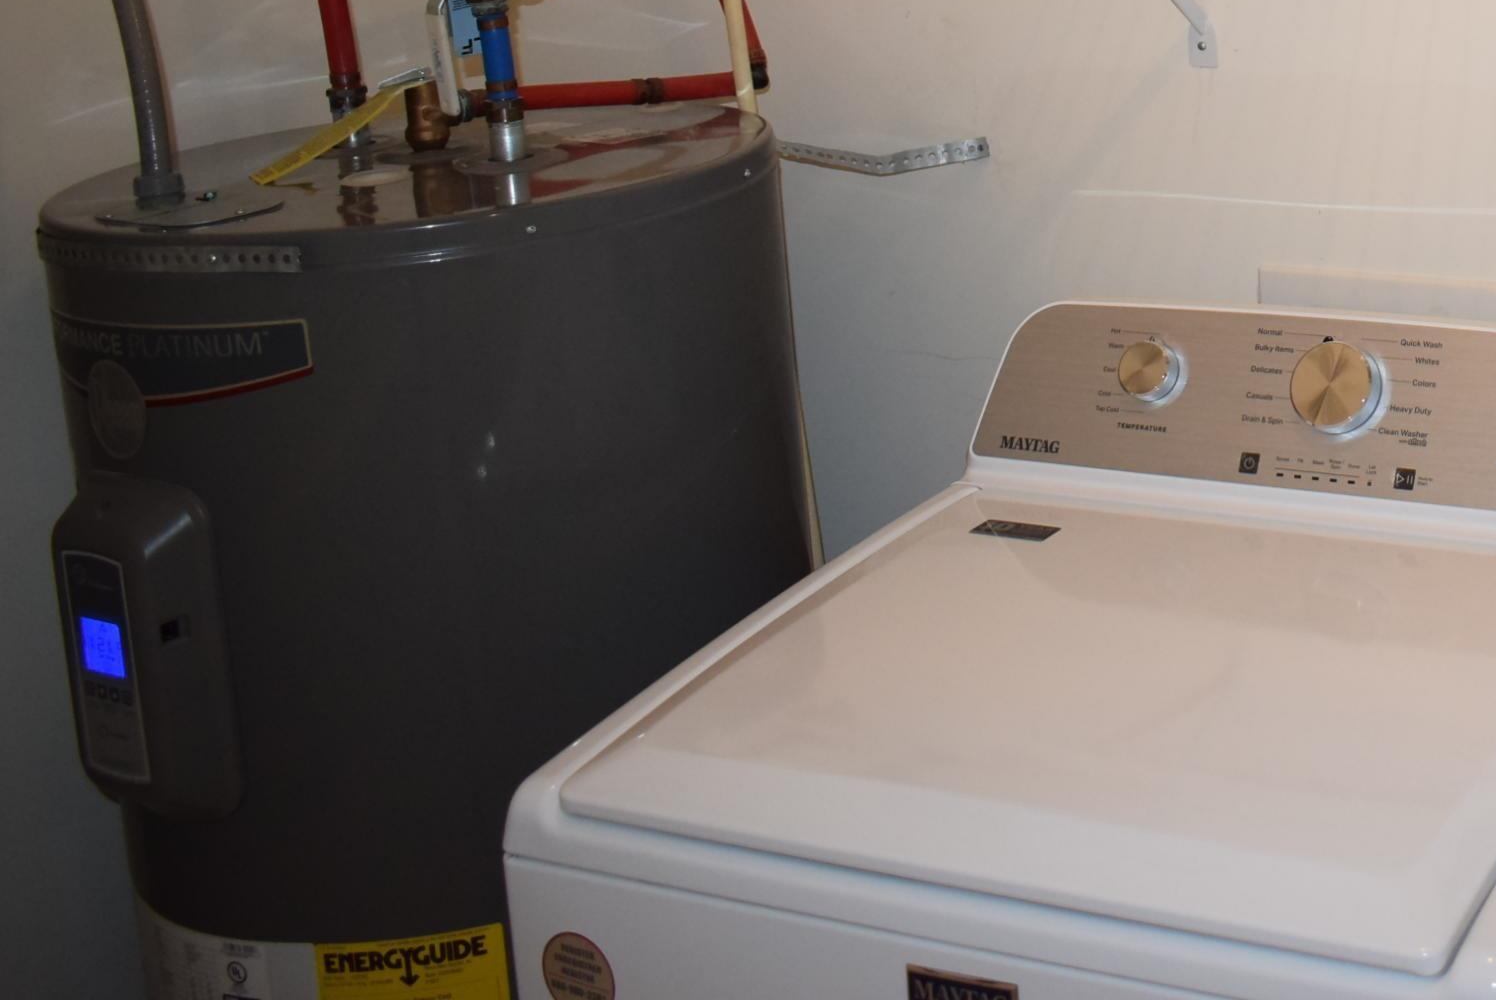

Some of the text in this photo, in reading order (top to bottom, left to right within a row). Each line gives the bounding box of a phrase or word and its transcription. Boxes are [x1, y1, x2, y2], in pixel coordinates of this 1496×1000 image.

[1257, 327, 1283, 336] Normal
[1254, 343, 1273, 353] Bulky
[1400, 338, 1443, 349] Quick Wash
[1414, 356, 1440, 366] Whites
[1250, 365, 1283, 375] Delicates
[1412, 379, 1437, 388] Colors
[1389, 404, 1433, 416] Heavy Duty
[1116, 422, 1168, 433] TEMPERATURE
[1378, 427, 1428, 438] Clean Washer
[999, 435, 1060, 454] MAYTAG
[324, 935, 488, 982] ENERGYGUIDE
[912, 979, 1008, 1000] MAYT
